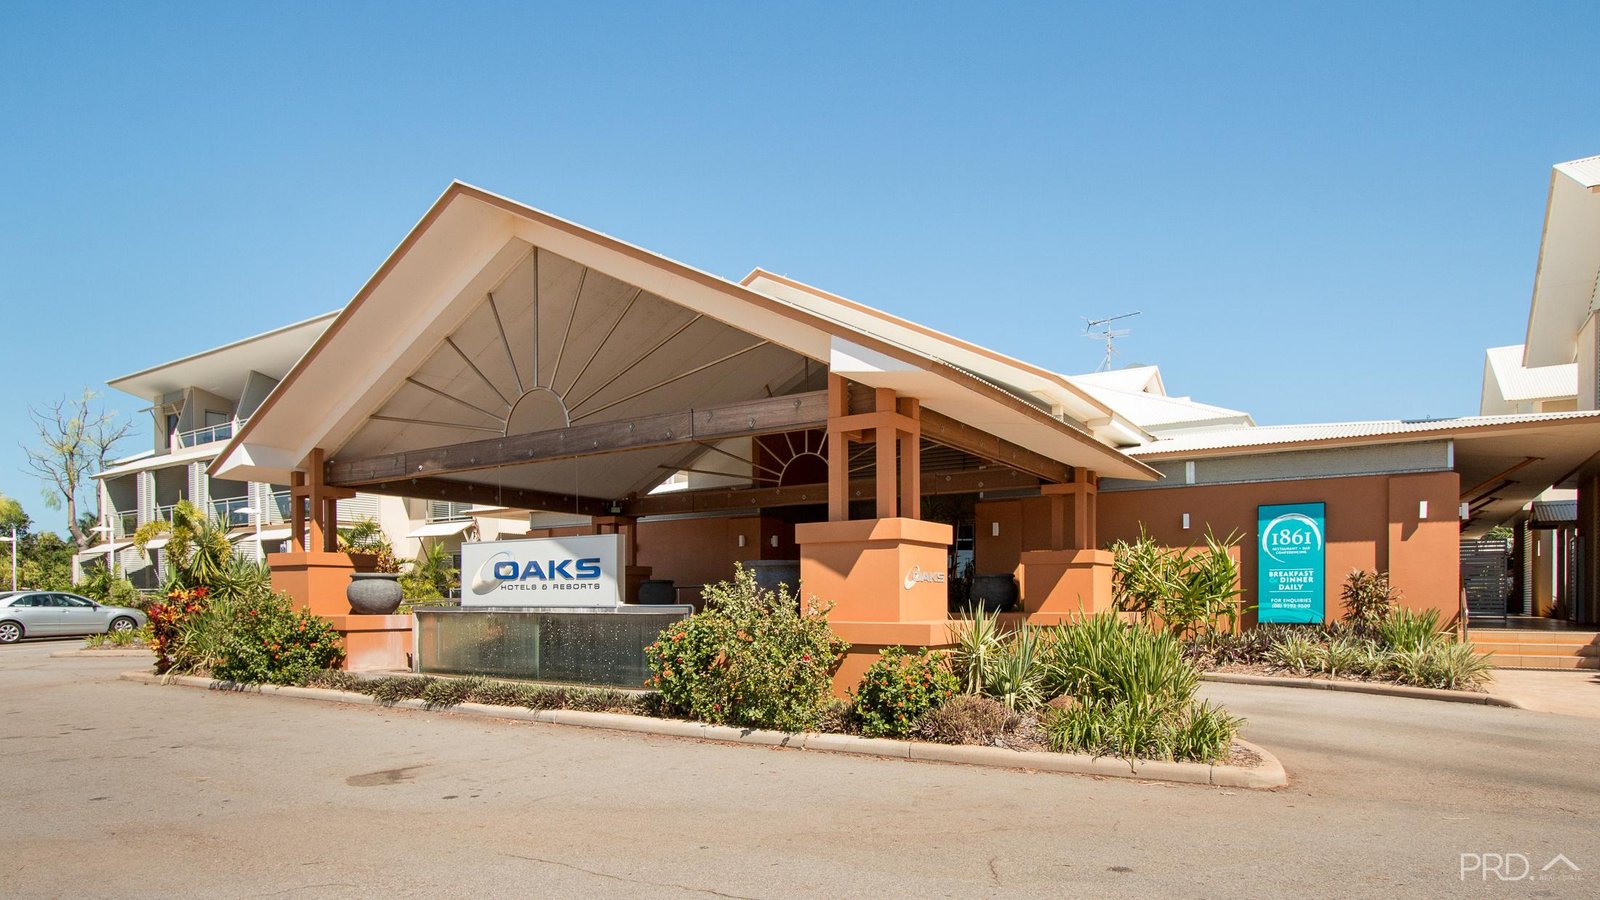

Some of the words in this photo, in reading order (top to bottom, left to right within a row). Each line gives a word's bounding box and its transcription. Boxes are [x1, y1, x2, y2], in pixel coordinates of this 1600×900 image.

[1272, 528, 1311, 545] 1861
[494, 558, 601, 580] OAKS
[912, 571, 945, 583] OAKS
